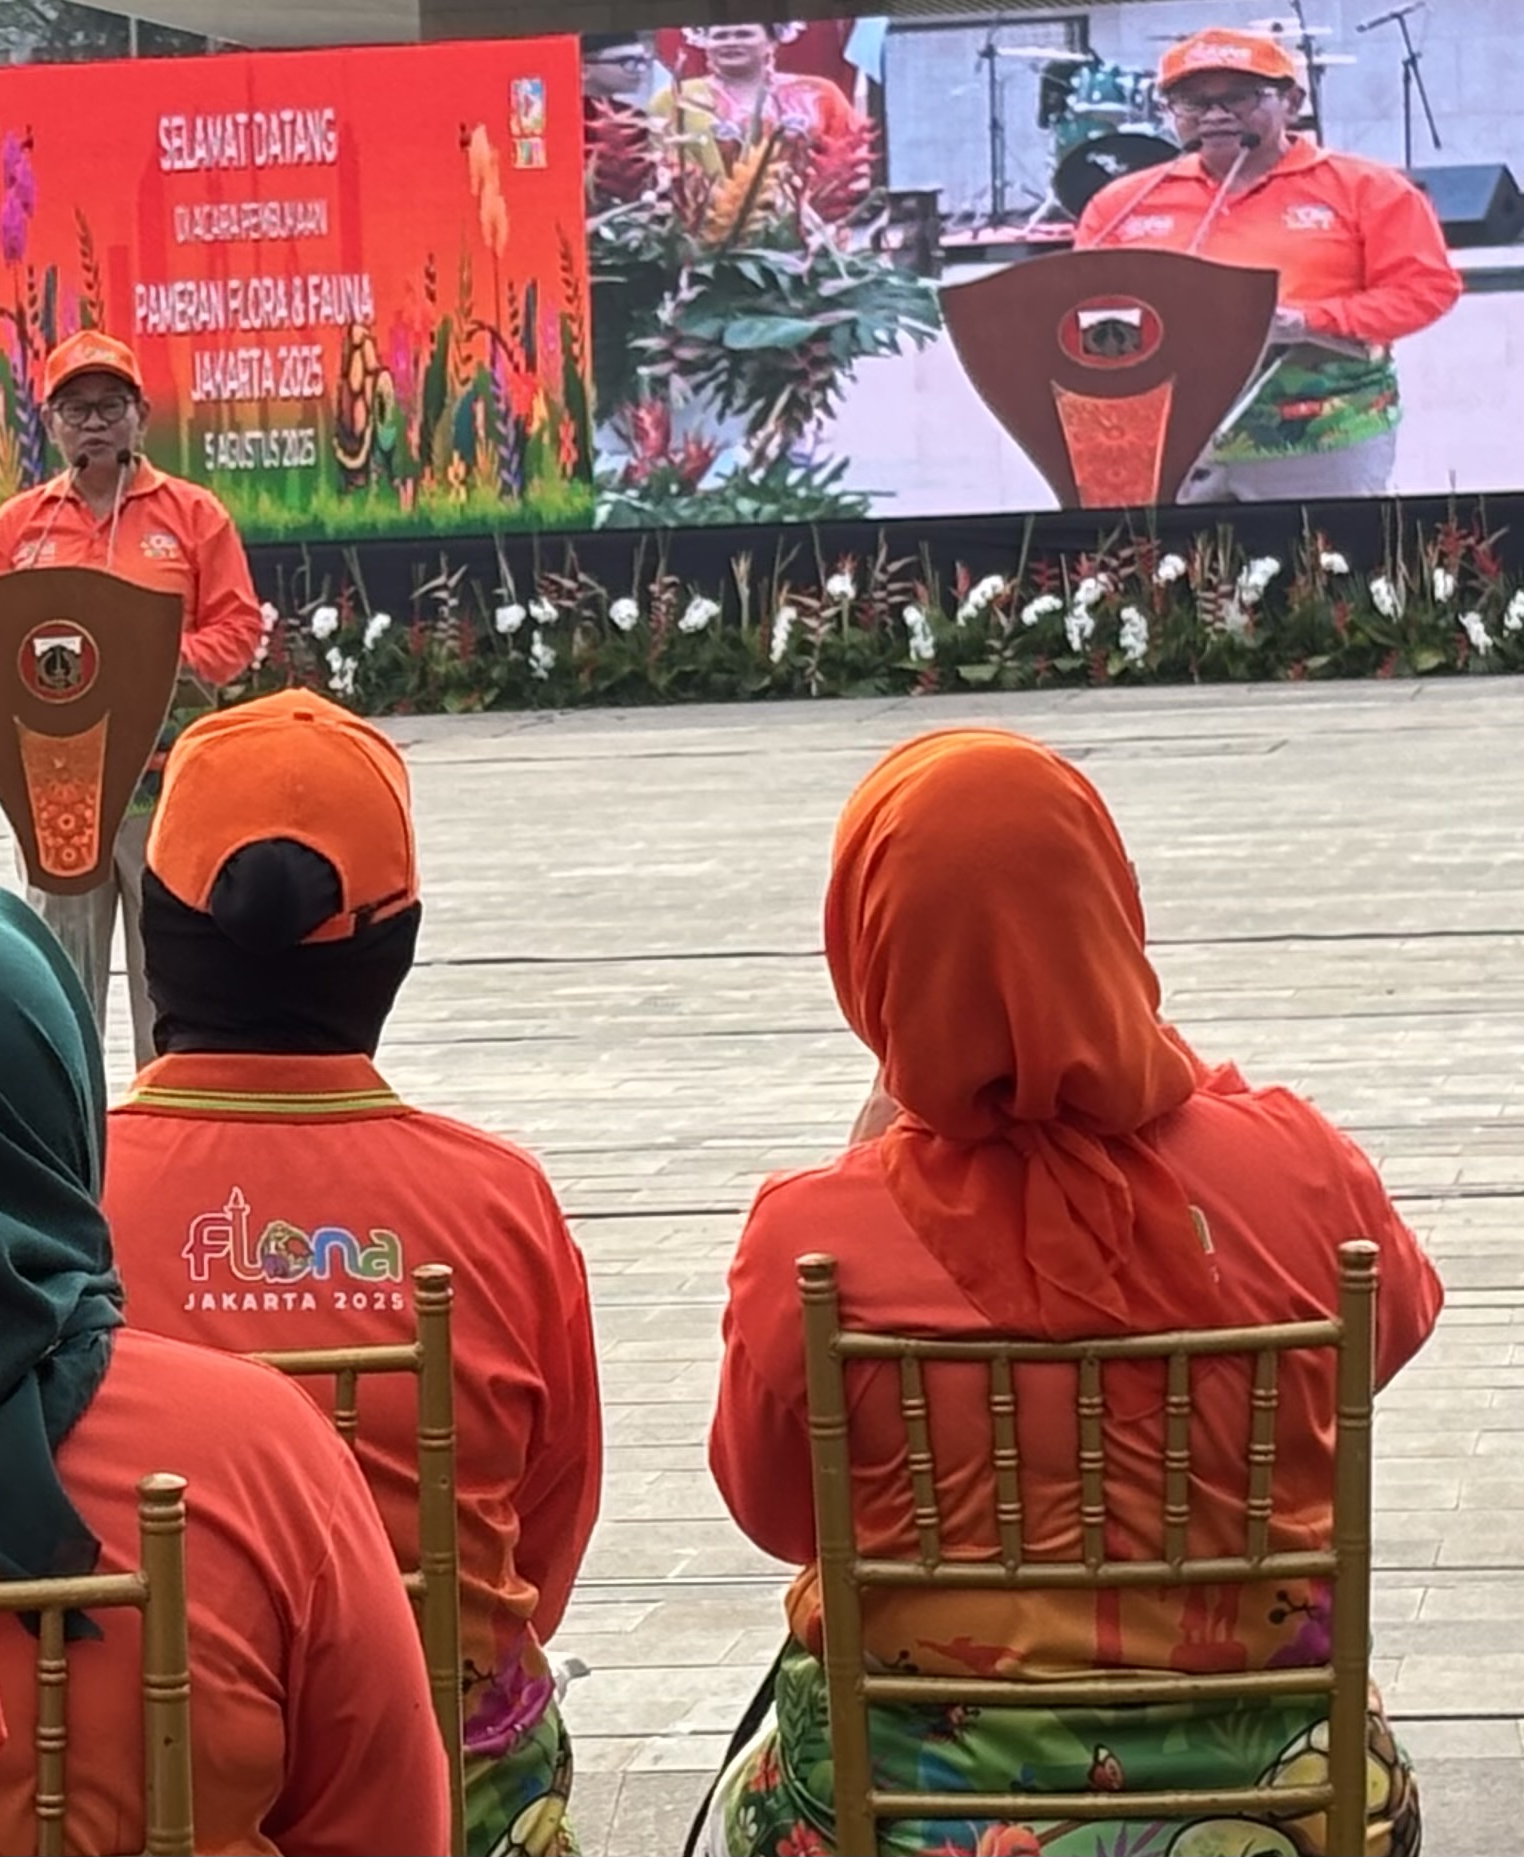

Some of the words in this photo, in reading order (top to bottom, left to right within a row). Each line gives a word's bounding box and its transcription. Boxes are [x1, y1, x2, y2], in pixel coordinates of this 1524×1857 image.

[159, 112, 249, 171] SELAMAT
[252, 108, 337, 167] DATANG
[135, 280, 225, 335] PAMERAN
[229, 276, 289, 330] FLORA
[291, 276, 305, 328] &
[308, 273, 374, 326] FAUNA
[191, 348, 275, 401] JAKARTA
[278, 344, 323, 398] 2025
[204, 431, 215, 470] 5
[217, 429, 280, 470] AGUSTUS
[281, 427, 317, 467] 2025
[184, 1292, 317, 1311] JAKARTA
[334, 1292, 405, 1311] 2025
